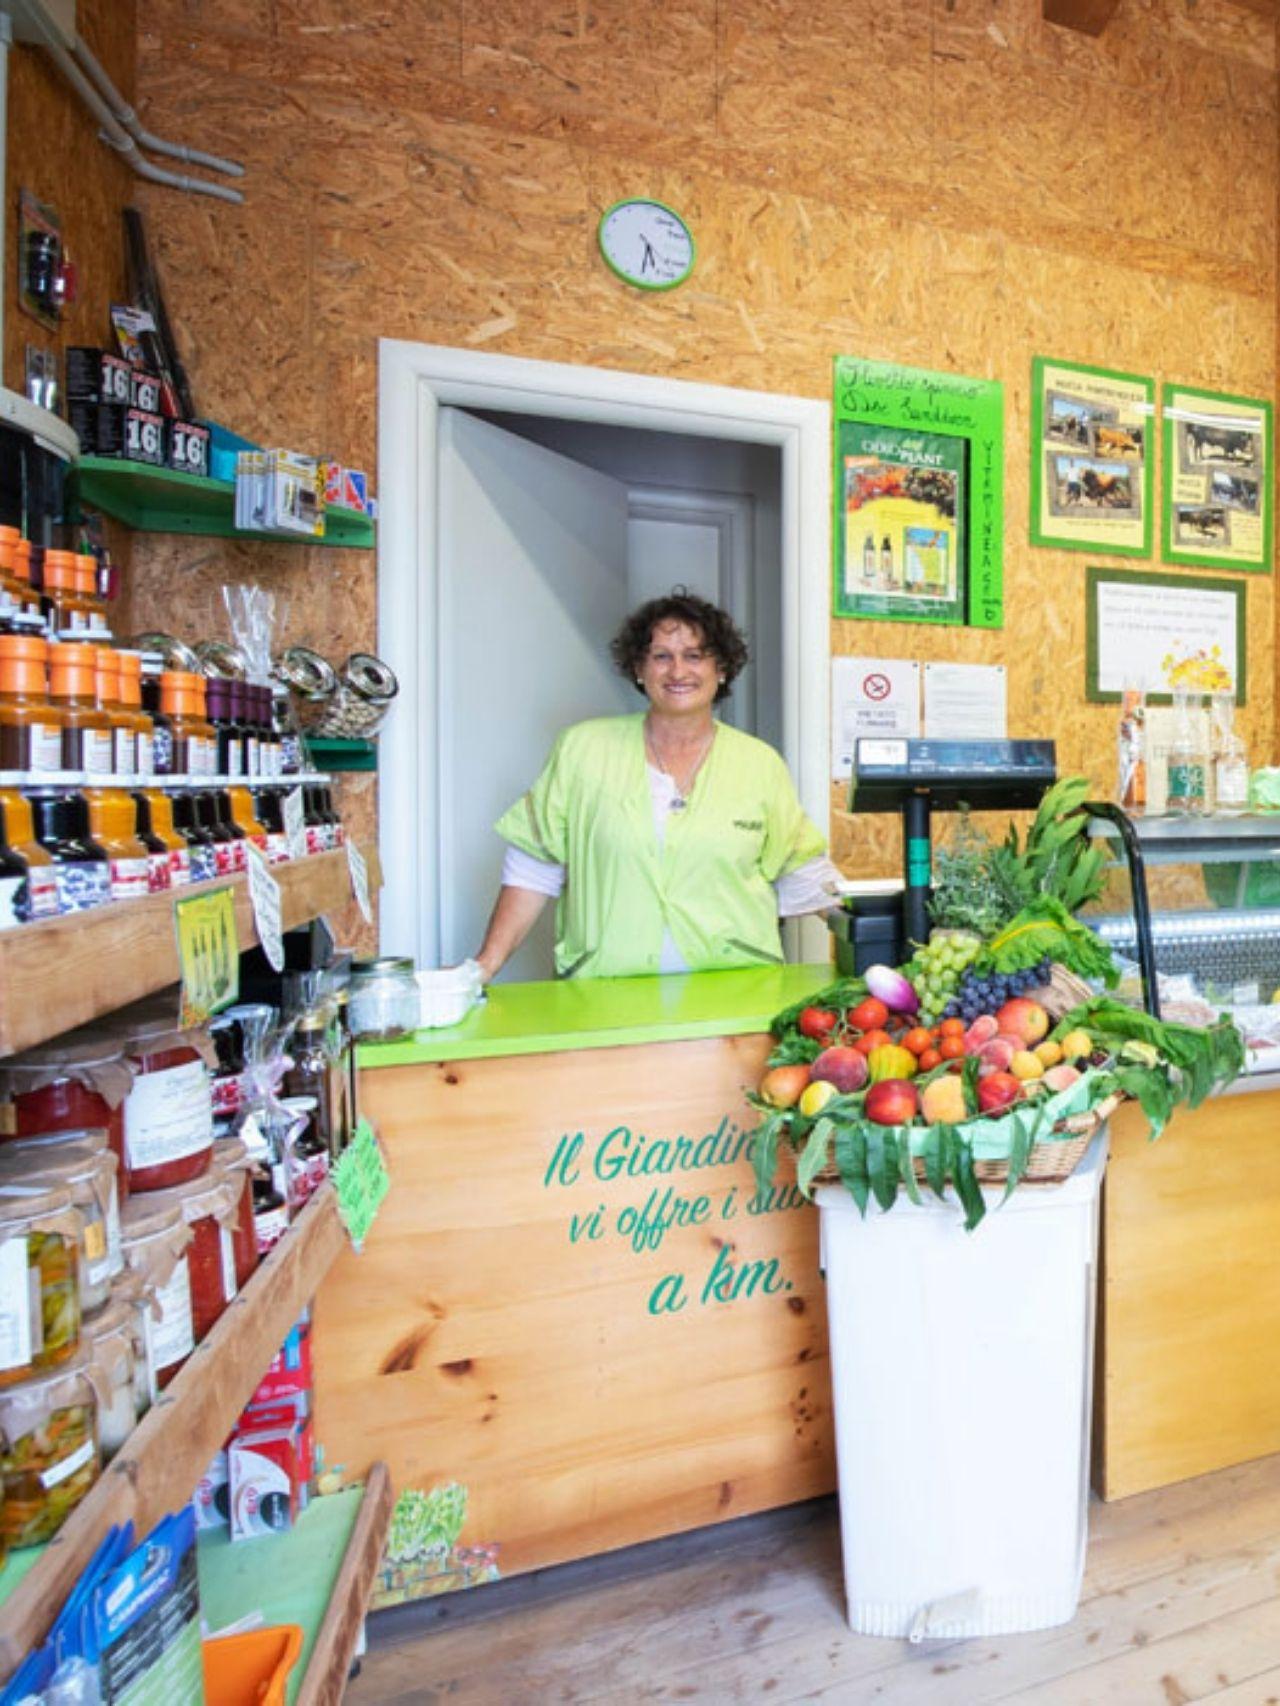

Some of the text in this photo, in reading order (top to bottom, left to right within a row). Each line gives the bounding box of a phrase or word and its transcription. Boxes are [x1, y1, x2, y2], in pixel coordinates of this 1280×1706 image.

[101, 364, 127, 399] 16
[128, 419, 157, 454] 16
[174, 431, 201, 465] 16
[544, 1115, 755, 1188] Il Giardin
[569, 1203, 606, 1244] vi
[616, 1186, 712, 1253] offre
[721, 1187, 738, 1220] i
[648, 1243, 793, 1316] a km.
